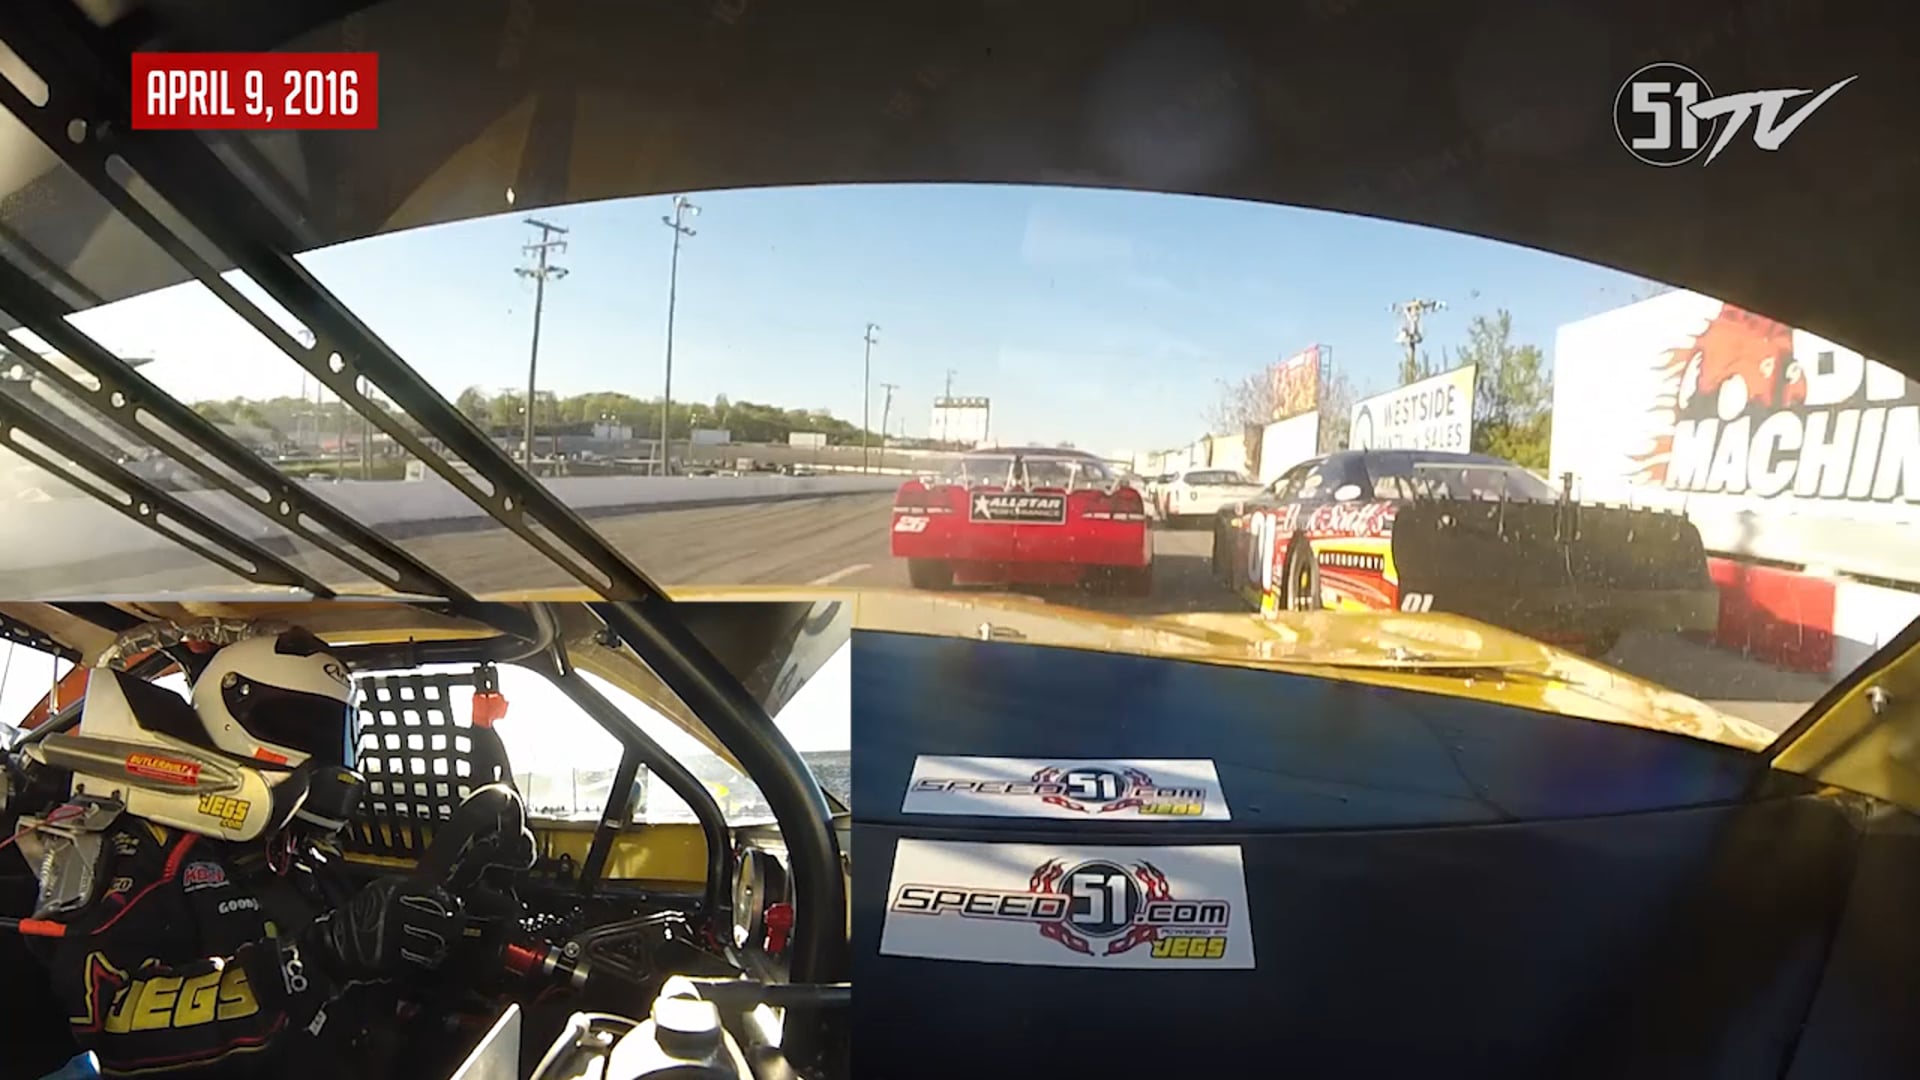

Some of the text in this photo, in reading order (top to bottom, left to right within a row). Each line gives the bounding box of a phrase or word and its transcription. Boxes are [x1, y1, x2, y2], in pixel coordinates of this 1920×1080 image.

[1384, 384, 1455, 427] WESTSIDE
[1424, 423, 1462, 449] SALES
[990, 498, 1061, 508] ALLSTAR
[894, 515, 930, 533] 26
[1401, 593, 1434, 613] 01
[912, 778, 1066, 796] SPEED
[1069, 773, 1116, 799] 51
[199, 794, 250, 822] JEGS
[898, 887, 1069, 920] SPEED
[1071, 874, 1127, 925] 51
[1151, 936, 1227, 958] JEGS
[104, 967, 259, 1033] JEGS
